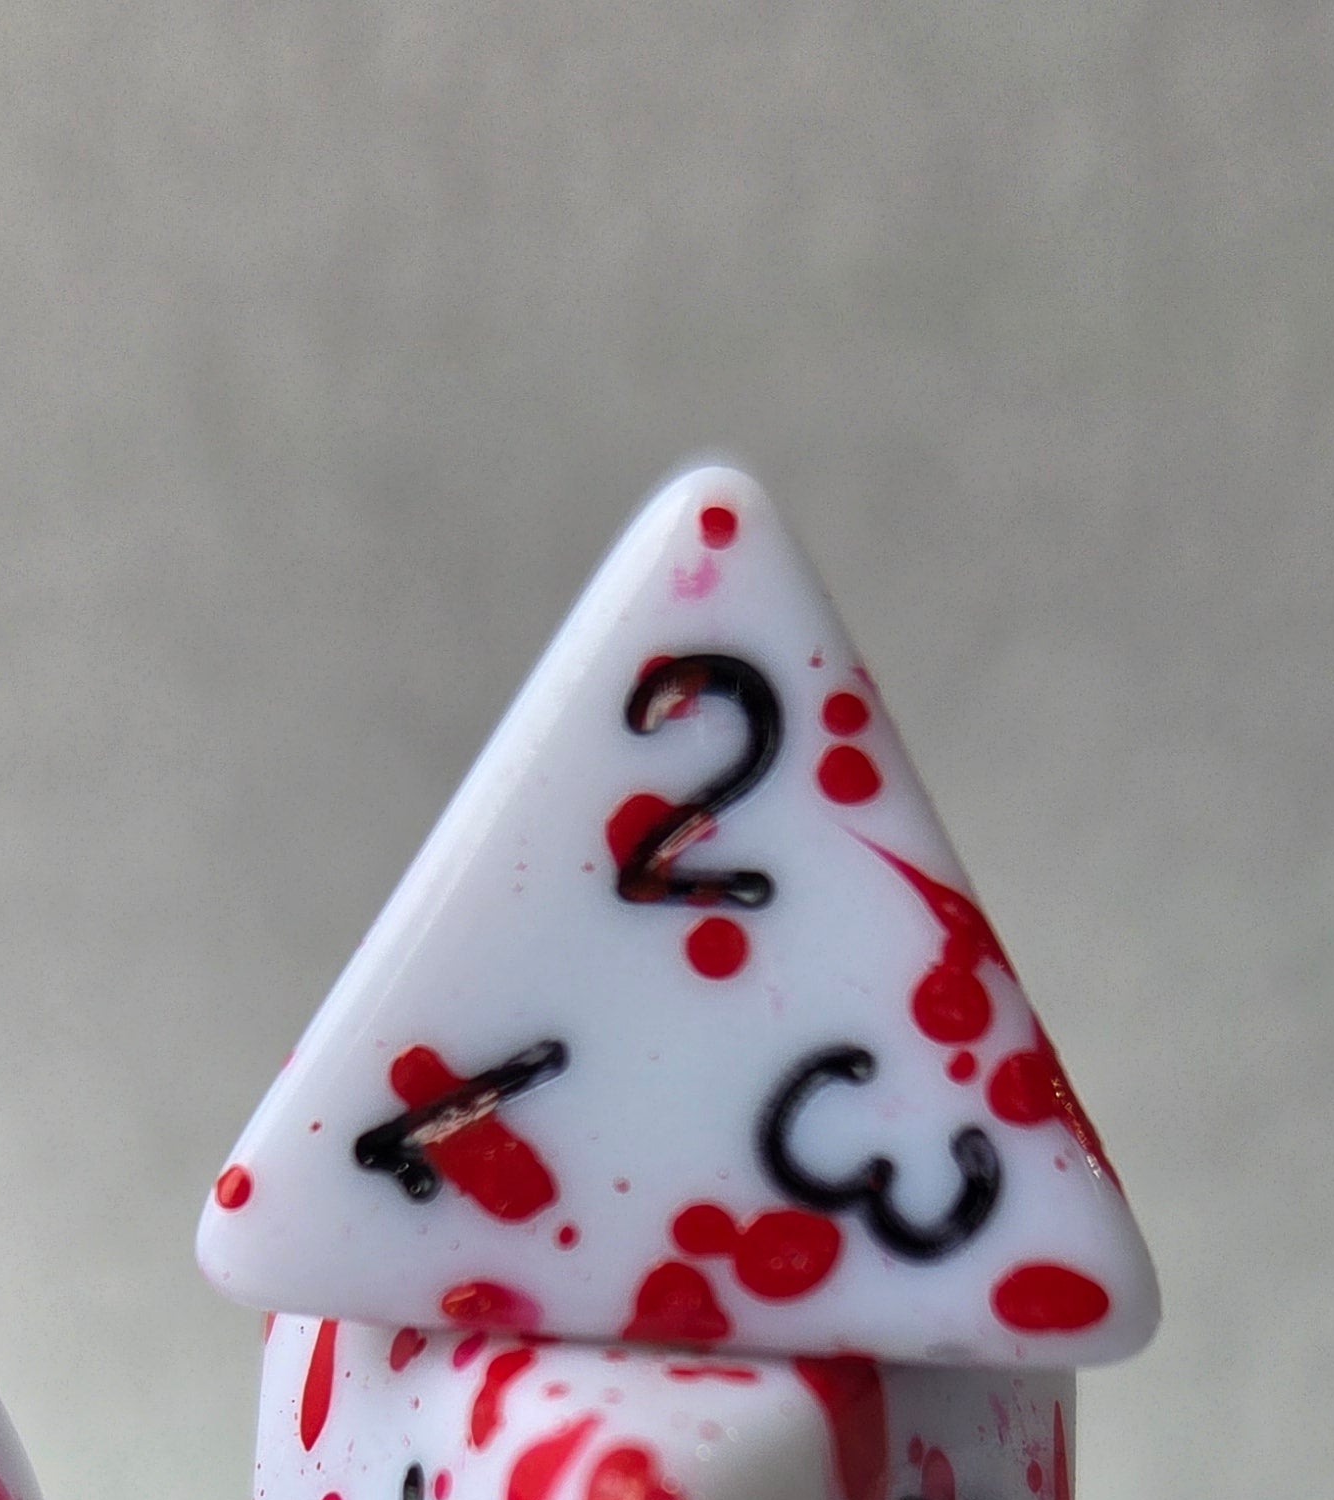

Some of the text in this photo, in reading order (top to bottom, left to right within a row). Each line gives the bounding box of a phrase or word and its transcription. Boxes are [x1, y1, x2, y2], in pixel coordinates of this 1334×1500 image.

[615, 654, 783, 906] 2
[353, 1038, 569, 1204] 1
[757, 1046, 1003, 1260] 3
